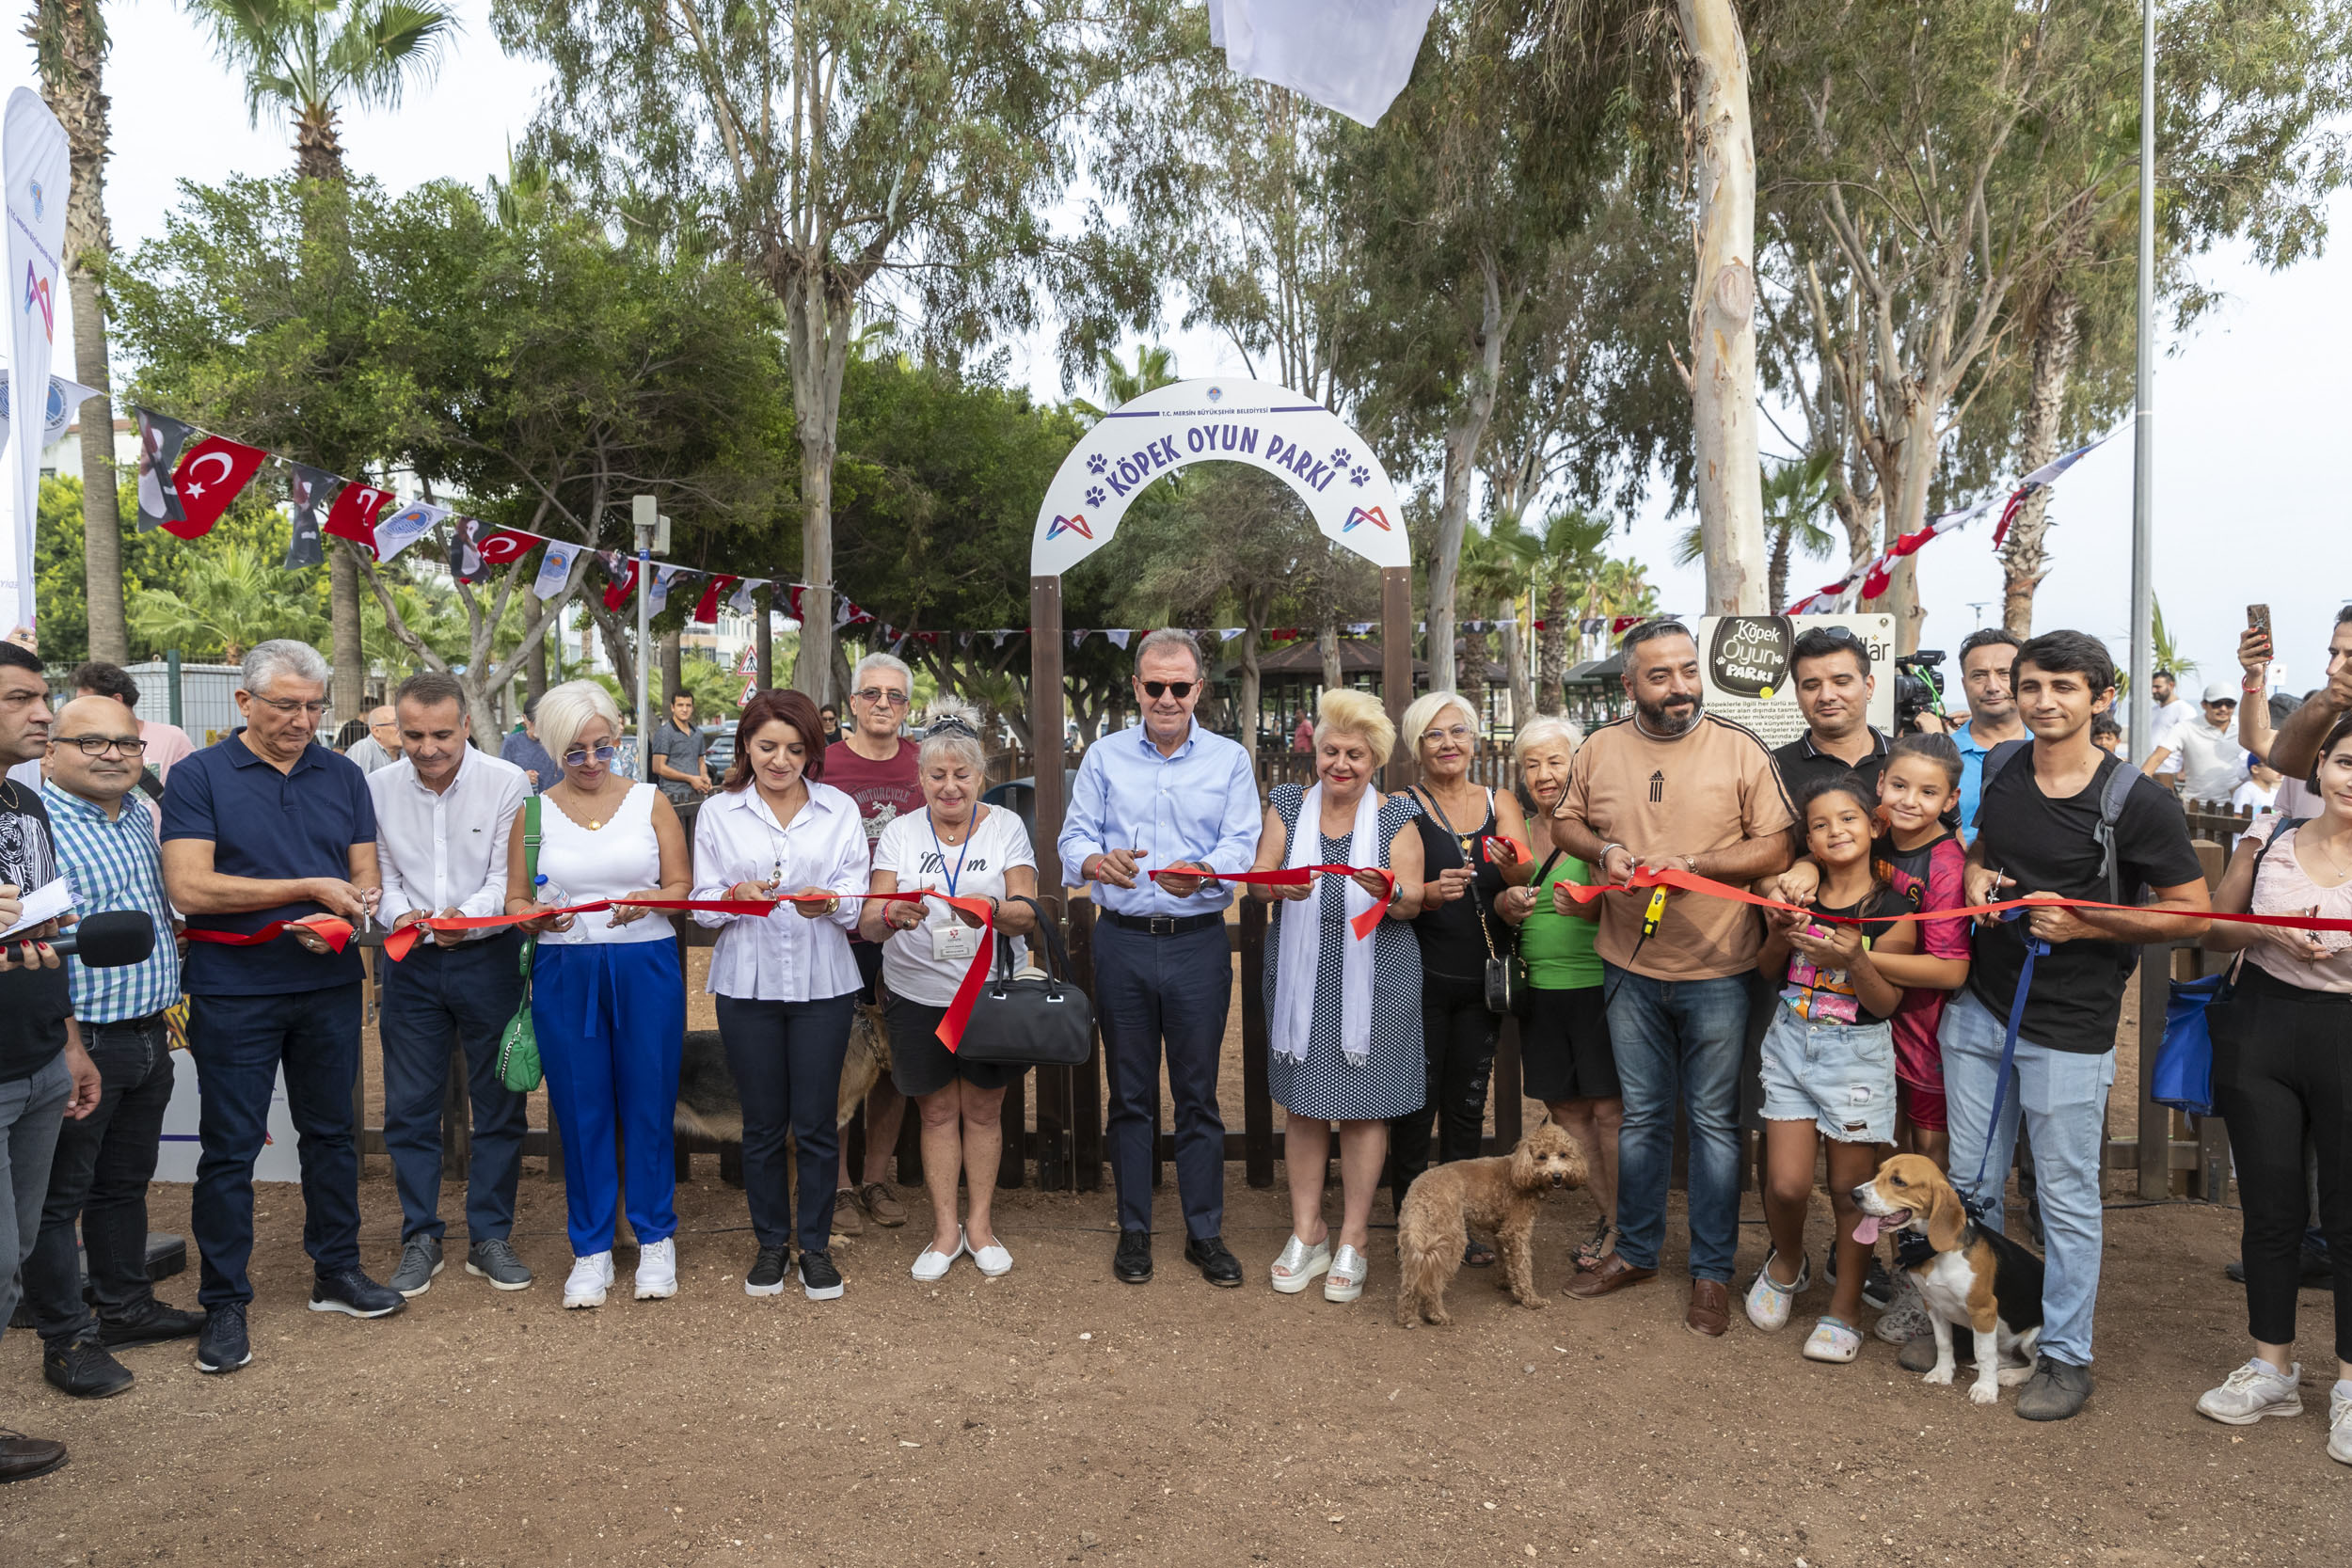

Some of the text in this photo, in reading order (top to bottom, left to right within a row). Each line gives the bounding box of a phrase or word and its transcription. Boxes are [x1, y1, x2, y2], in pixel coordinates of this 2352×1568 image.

[1173, 408, 1196, 417] MERSİN
[1198, 407, 1235, 417] BÜYÜKŞEHİR
[1236, 405, 1269, 415] BELEDİYESİ
[1104, 423, 1337, 498] KÖPEK OYUN PARKI
[1733, 619, 1780, 644] Köpek
[1723, 640, 1775, 666] Oyun
[1725, 663, 1773, 683] PARKI
[1742, 699, 1756, 707] ilgili
[854, 785, 911, 806] MOTORCYCLE
